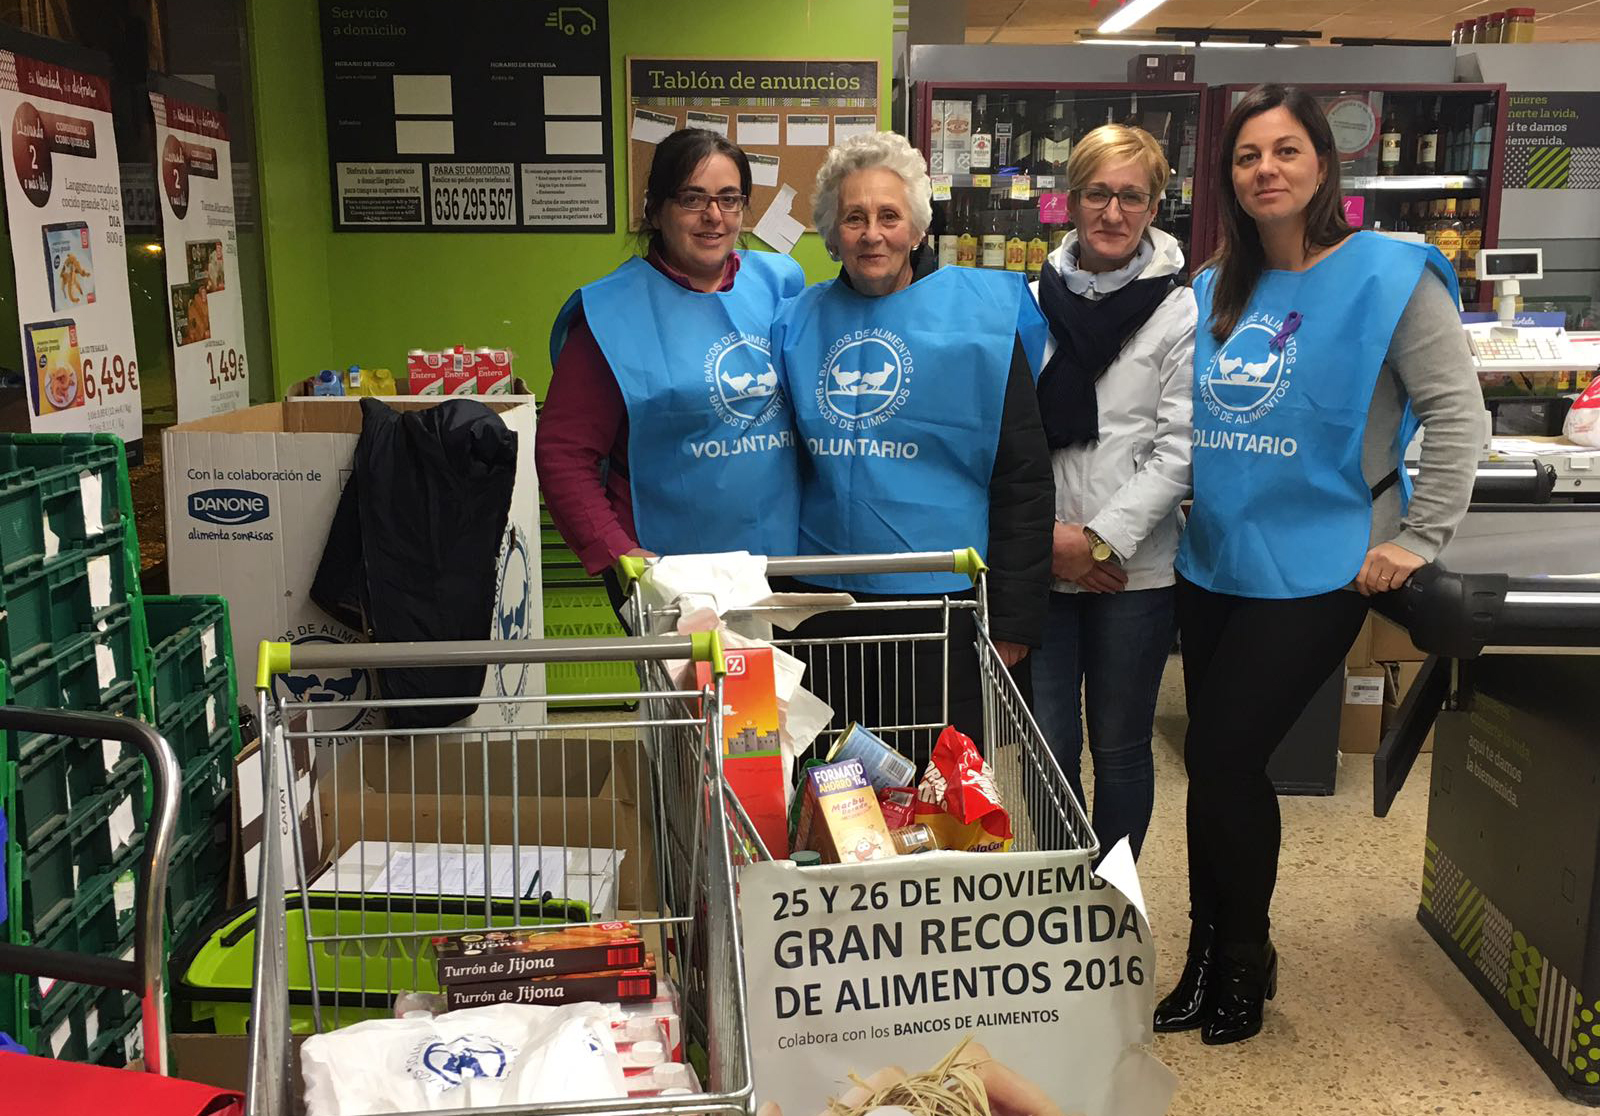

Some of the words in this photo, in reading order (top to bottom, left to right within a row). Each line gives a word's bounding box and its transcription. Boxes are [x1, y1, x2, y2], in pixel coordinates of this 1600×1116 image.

[332, 6, 388, 19] Servicio
[333, 27, 341, 36] a
[343, 23, 407, 36] domicilio
[649, 70, 726, 91] Tablón
[730, 70, 756, 90] de
[760, 71, 861, 91] anuncios
[1540, 108, 1550, 118] la
[1552, 108, 1580, 120] vida,
[1516, 124, 1528, 132] te
[1529, 122, 1568, 132] damos
[28, 144, 39, 170] 2
[173, 168, 181, 189] 2
[434, 166, 454, 175] PARA
[455, 166, 465, 175] SU
[466, 166, 511, 175] COMODIDAD
[458, 177, 475, 185] pedido
[61, 197, 80, 208] cocido
[80, 198, 100, 212] grande
[434, 187, 460, 221] 636
[461, 187, 488, 221] 295
[489, 187, 514, 221] 567
[108, 215, 121, 228] DIA
[106, 231, 118, 244] 800
[703, 341, 723, 383] BANCOS
[720, 331, 738, 346] DE
[819, 333, 852, 378] BANCOS
[854, 329, 870, 340] DE
[871, 327, 914, 375] ALIMENTOS
[815, 387, 839, 425] BANCOS
[838, 418, 855, 432] DE
[855, 388, 911, 431] ALIMENTOS
[1199, 373, 1220, 417] BANCOS
[1219, 410, 1234, 424] DE
[1234, 379, 1291, 425] ALIMENTOS
[691, 430, 795, 459] VOLUNTARI
[807, 438, 919, 460] OLUNTARIO
[1192, 428, 1298, 458] OLUNTARIO
[187, 468, 210, 480] Con
[214, 468, 224, 480] la
[227, 468, 304, 481] colaboración
[306, 469, 322, 481] de
[188, 527, 230, 541] alimenta
[298, 623, 316, 636] DE
[1468, 734, 1486, 756] aquí
[1485, 746, 1495, 763] te
[1494, 750, 1522, 783] damos
[813, 762, 864, 784] FORMATO
[1466, 753, 1474, 774] la
[1473, 760, 1519, 809] bienvenida.
[818, 778, 852, 793] AHORRO
[772, 888, 809, 922] 25
[818, 885, 839, 914] Y
[849, 881, 889, 912] 26
[900, 877, 941, 908] DE
[953, 865, 1108, 903] NOVIEMB
[774, 920, 903, 970] GRAN
[920, 903, 1143, 956] RECOGIDA
[445, 965, 487, 978] Turrón
[490, 962, 504, 974] de
[507, 956, 556, 975] Jijona
[453, 992, 496, 1005] Turrón
[499, 990, 513, 1001] de
[516, 985, 565, 1003] Jijona
[775, 982, 824, 1019] DE
[834, 960, 1052, 1013] ALIMENTOS
[1062, 954, 1145, 992] 2016
[778, 1029, 839, 1050] Colabora
[841, 1028, 867, 1043] con
[870, 1024, 890, 1040] los
[893, 1018, 951, 1038] BANCOS
[954, 1015, 973, 1030] DE
[975, 1008, 1060, 1028] ALIMENTOS
